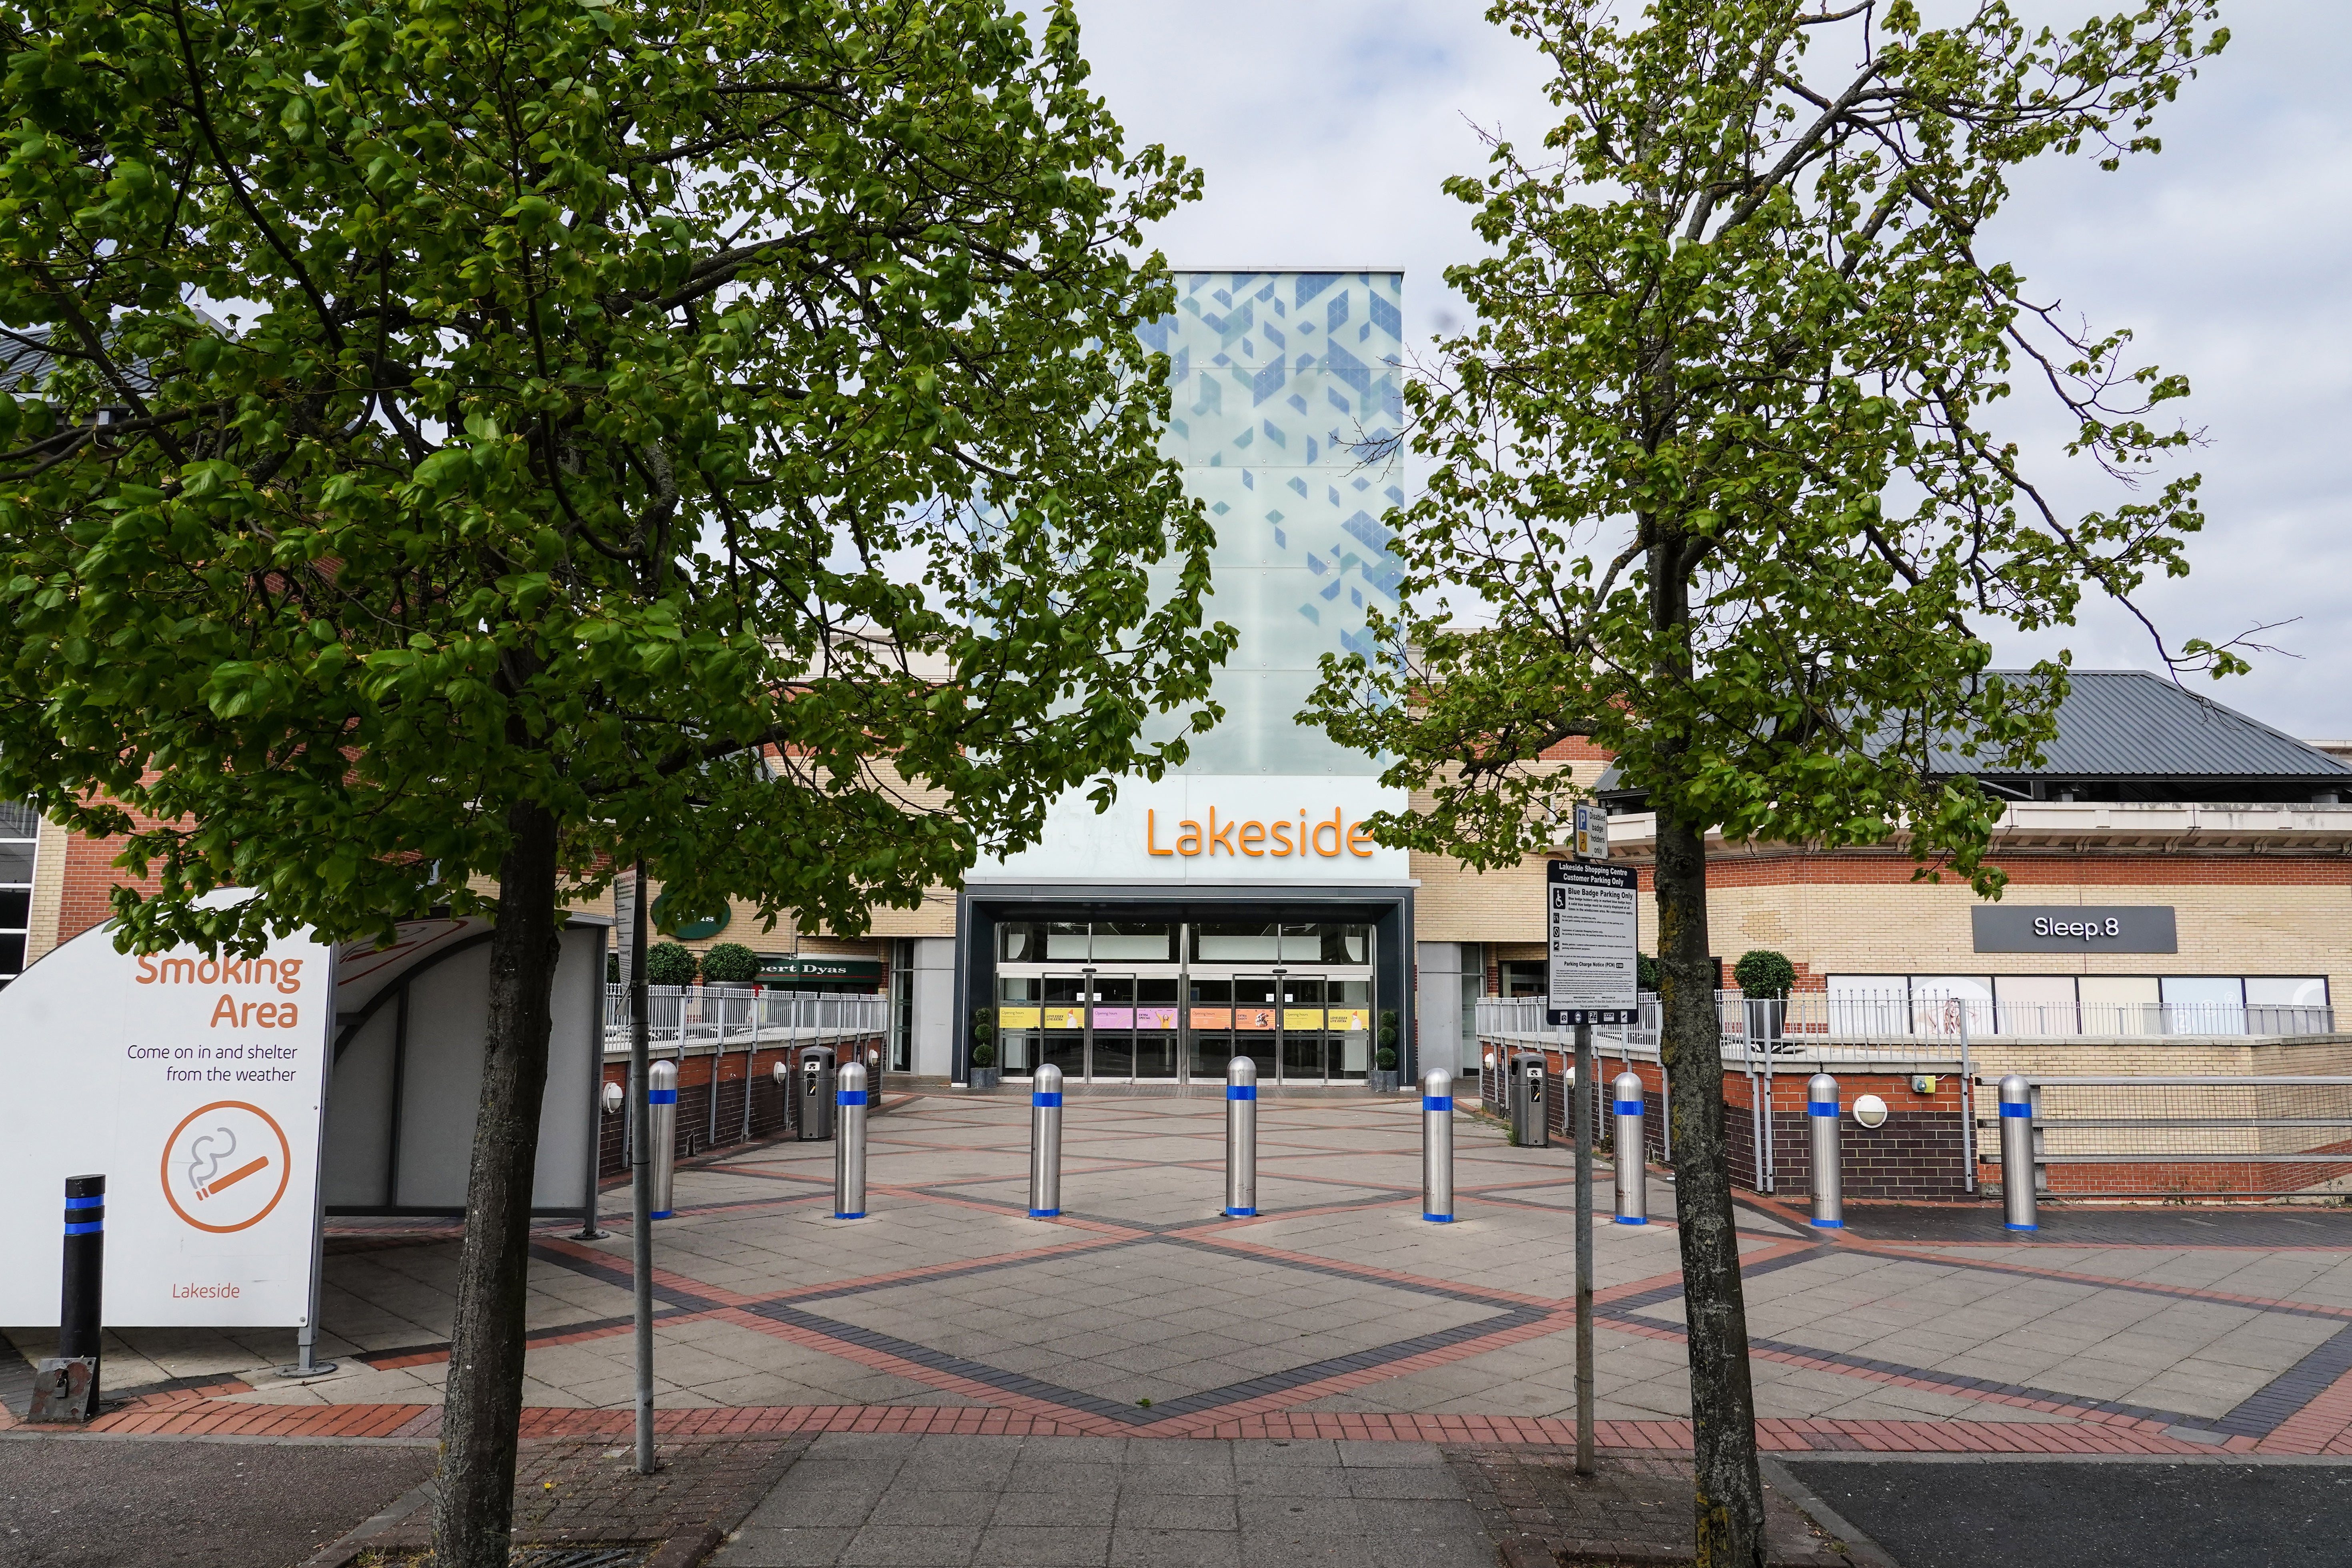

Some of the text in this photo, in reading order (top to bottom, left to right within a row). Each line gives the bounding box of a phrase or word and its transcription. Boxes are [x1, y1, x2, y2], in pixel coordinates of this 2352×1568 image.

[1589, 812, 1605, 822] Disabled
[1148, 806, 1373, 857] Lakeside
[1592, 823, 1603, 833] badge
[1591, 835, 1605, 843] holders
[1594, 847, 1602, 855] only
[1559, 862, 1627, 876] Lakeside Shopping Centre
[1563, 873, 1623, 887] Customer Parking Only
[1582, 888, 1599, 898] Badge
[1600, 890, 1620, 900] Parking
[1621, 892, 1633, 900] Only
[2034, 917, 2119, 941] Sleep.8
[136, 949, 303, 994] Smoking
[802, 964, 847, 974] Dyas
[210, 994, 298, 1028] Area
[128, 1044, 298, 1059] Come on in and shelter
[167, 1066, 296, 1081] from the weather
[173, 1282, 240, 1298] Lakeside
